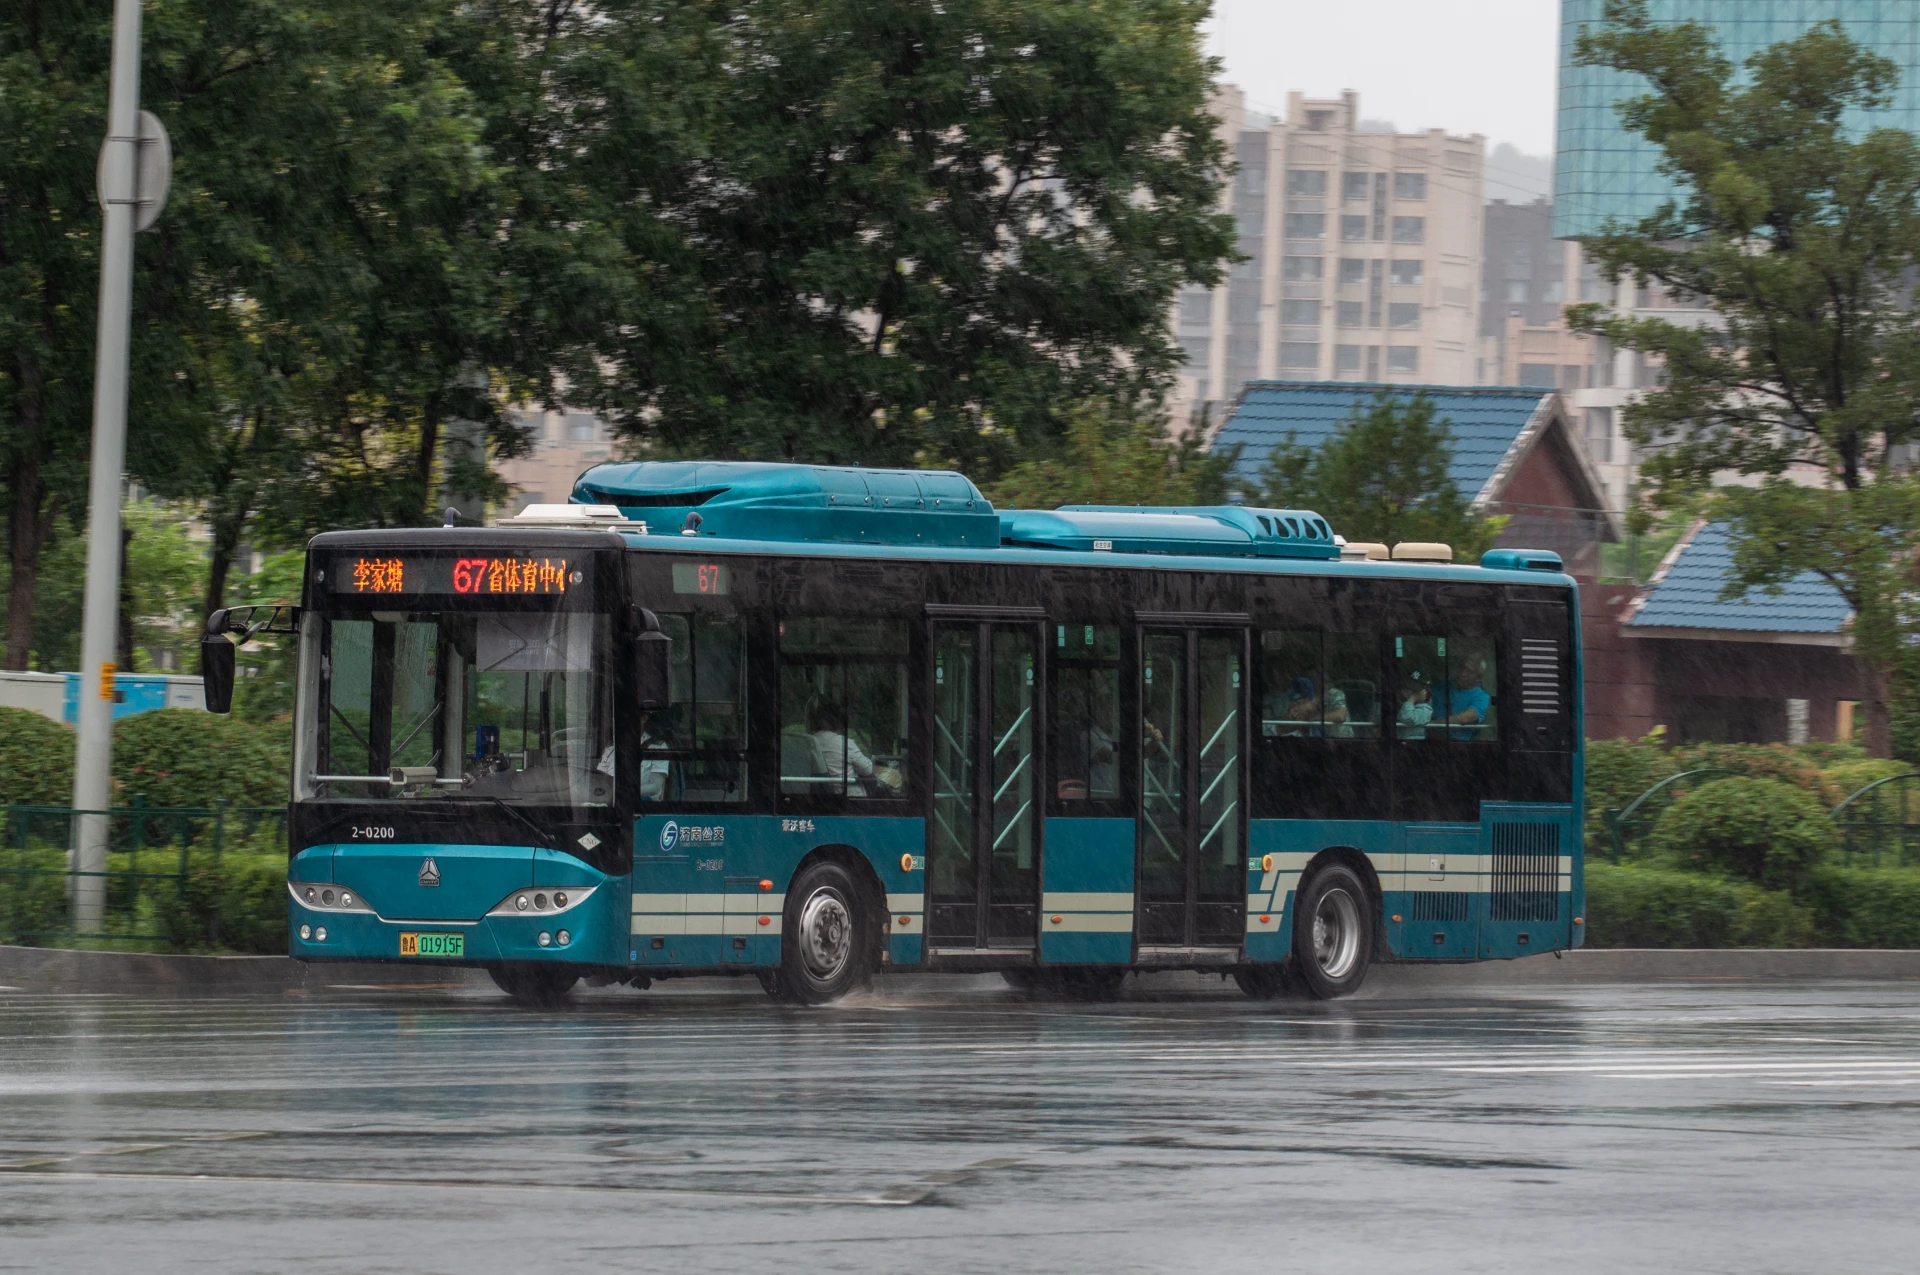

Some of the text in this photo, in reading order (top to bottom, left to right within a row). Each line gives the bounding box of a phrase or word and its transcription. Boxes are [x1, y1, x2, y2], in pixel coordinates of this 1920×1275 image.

[353, 558, 403, 592] 李家塘
[453, 559, 488, 593] 67
[698, 564, 719, 594] 67
[351, 826, 395, 839] 2-0200
[680, 826, 725, 842] 济南公交
